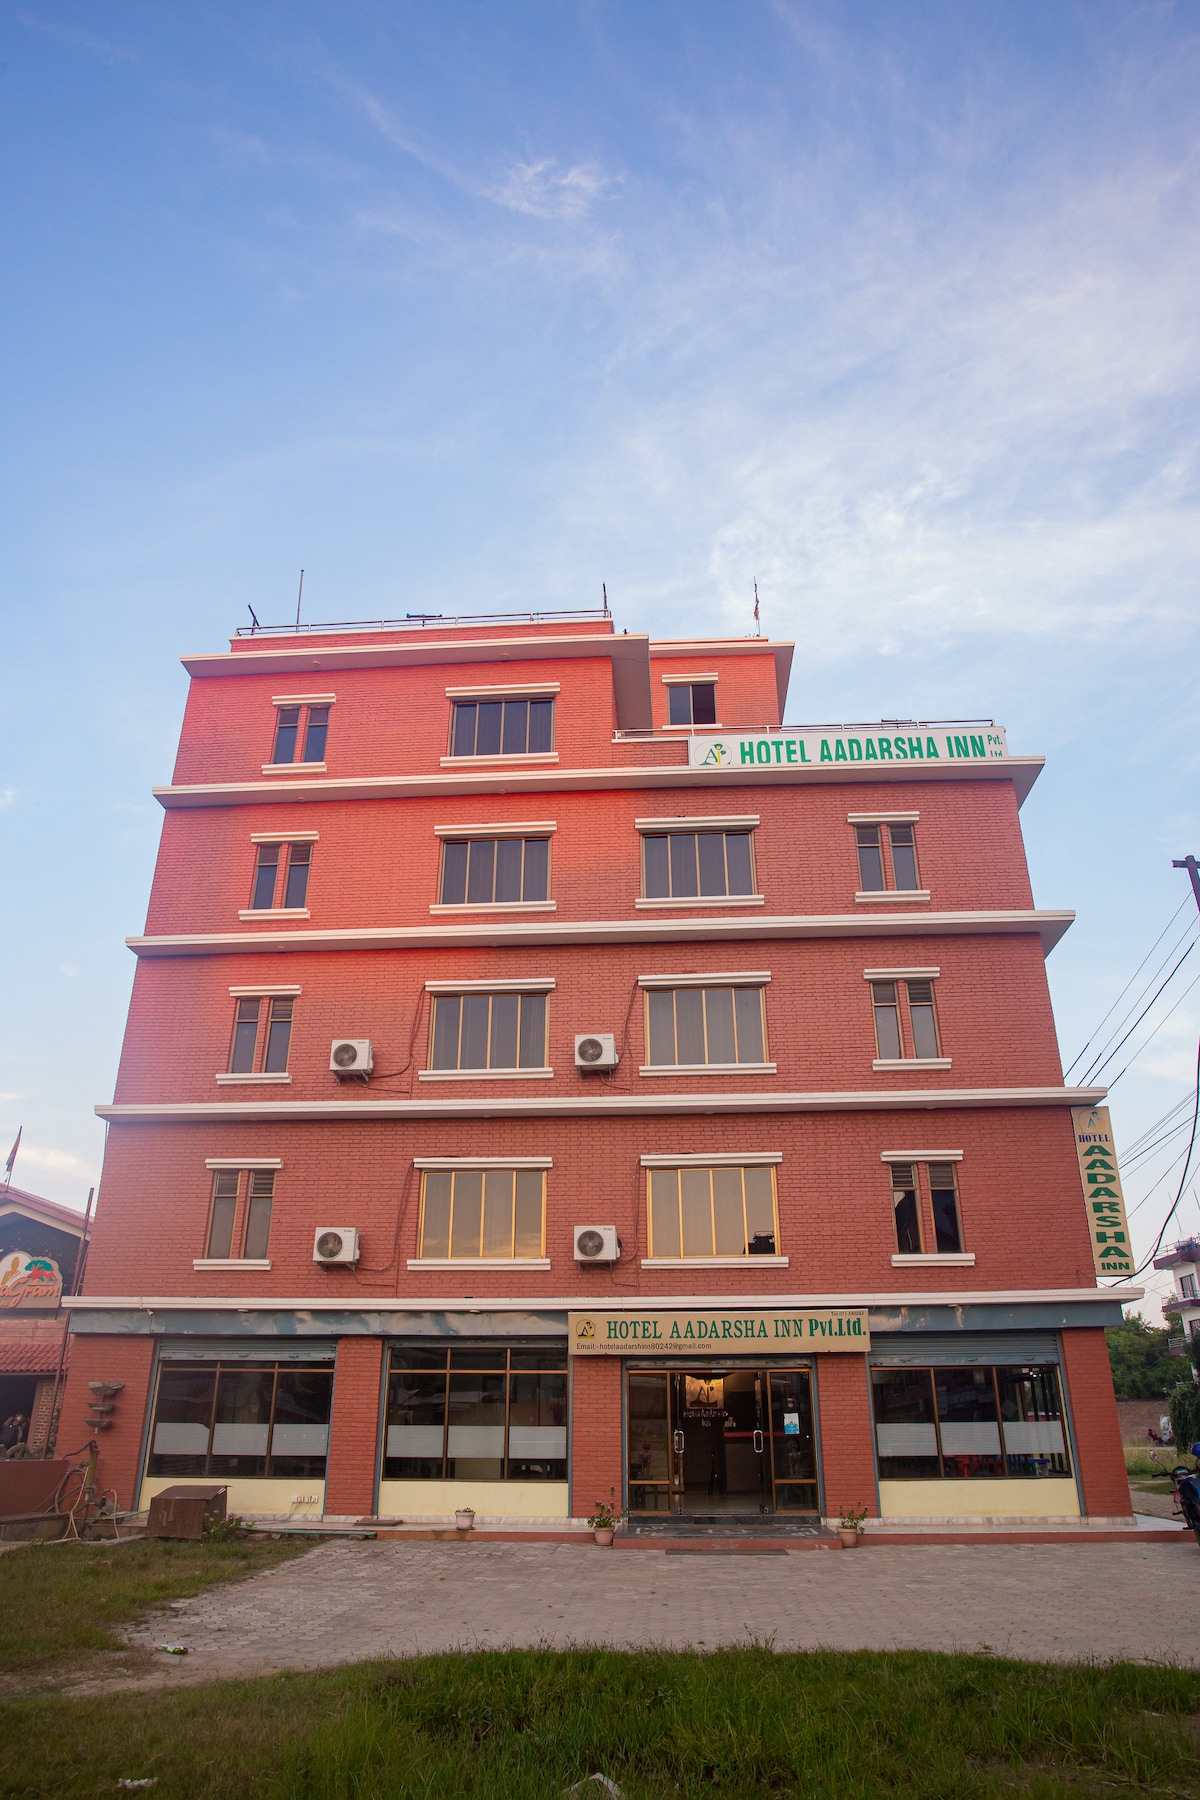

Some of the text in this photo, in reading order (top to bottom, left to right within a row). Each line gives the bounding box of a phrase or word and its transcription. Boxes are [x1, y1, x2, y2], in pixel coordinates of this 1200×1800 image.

[987, 734, 1003, 745] Pvt.
[739, 735, 987, 764] HOTEL AADARSHA INN
[1078, 1134, 1111, 1143] HOTEL
[1082, 1145, 1130, 1258] AADARSHA
[1101, 1262, 1130, 1271] INN
[607, 1320, 662, 1339] HOTEL
[669, 1319, 768, 1339] AADARSHA
[773, 1319, 803, 1338] INN
